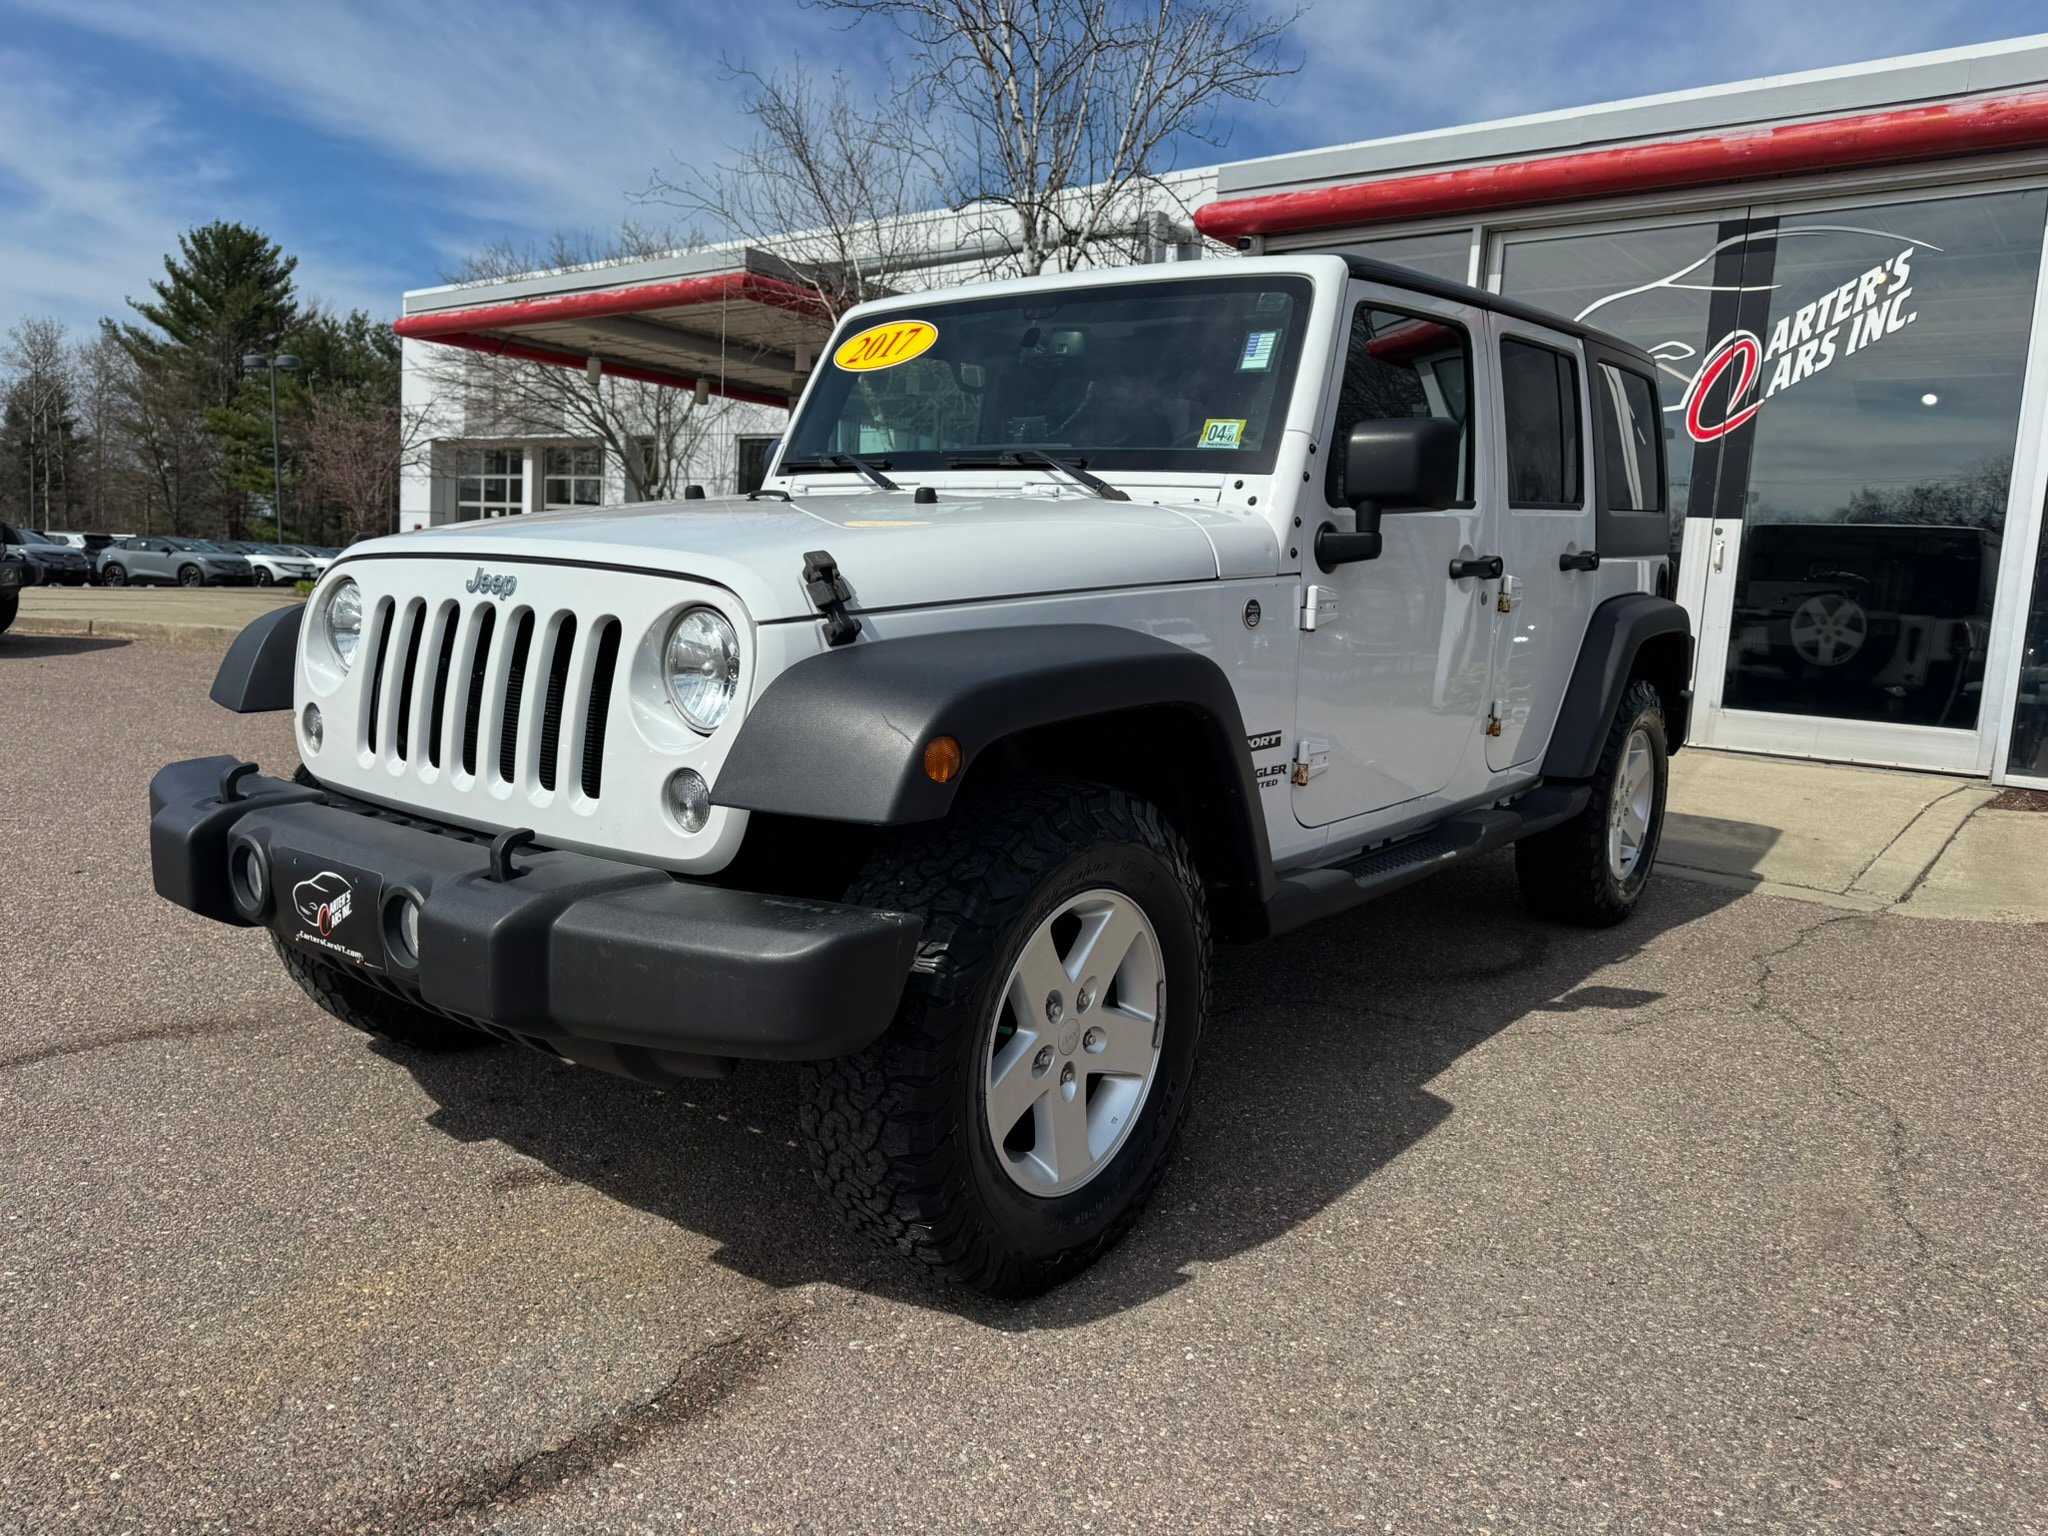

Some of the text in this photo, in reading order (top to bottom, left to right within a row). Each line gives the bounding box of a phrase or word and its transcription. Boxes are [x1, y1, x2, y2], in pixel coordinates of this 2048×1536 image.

[1845, 287, 1918, 356] INC.
[845, 327, 924, 364] 2017
[1207, 424, 1227, 441] 04
[466, 566, 517, 601] Jeep
